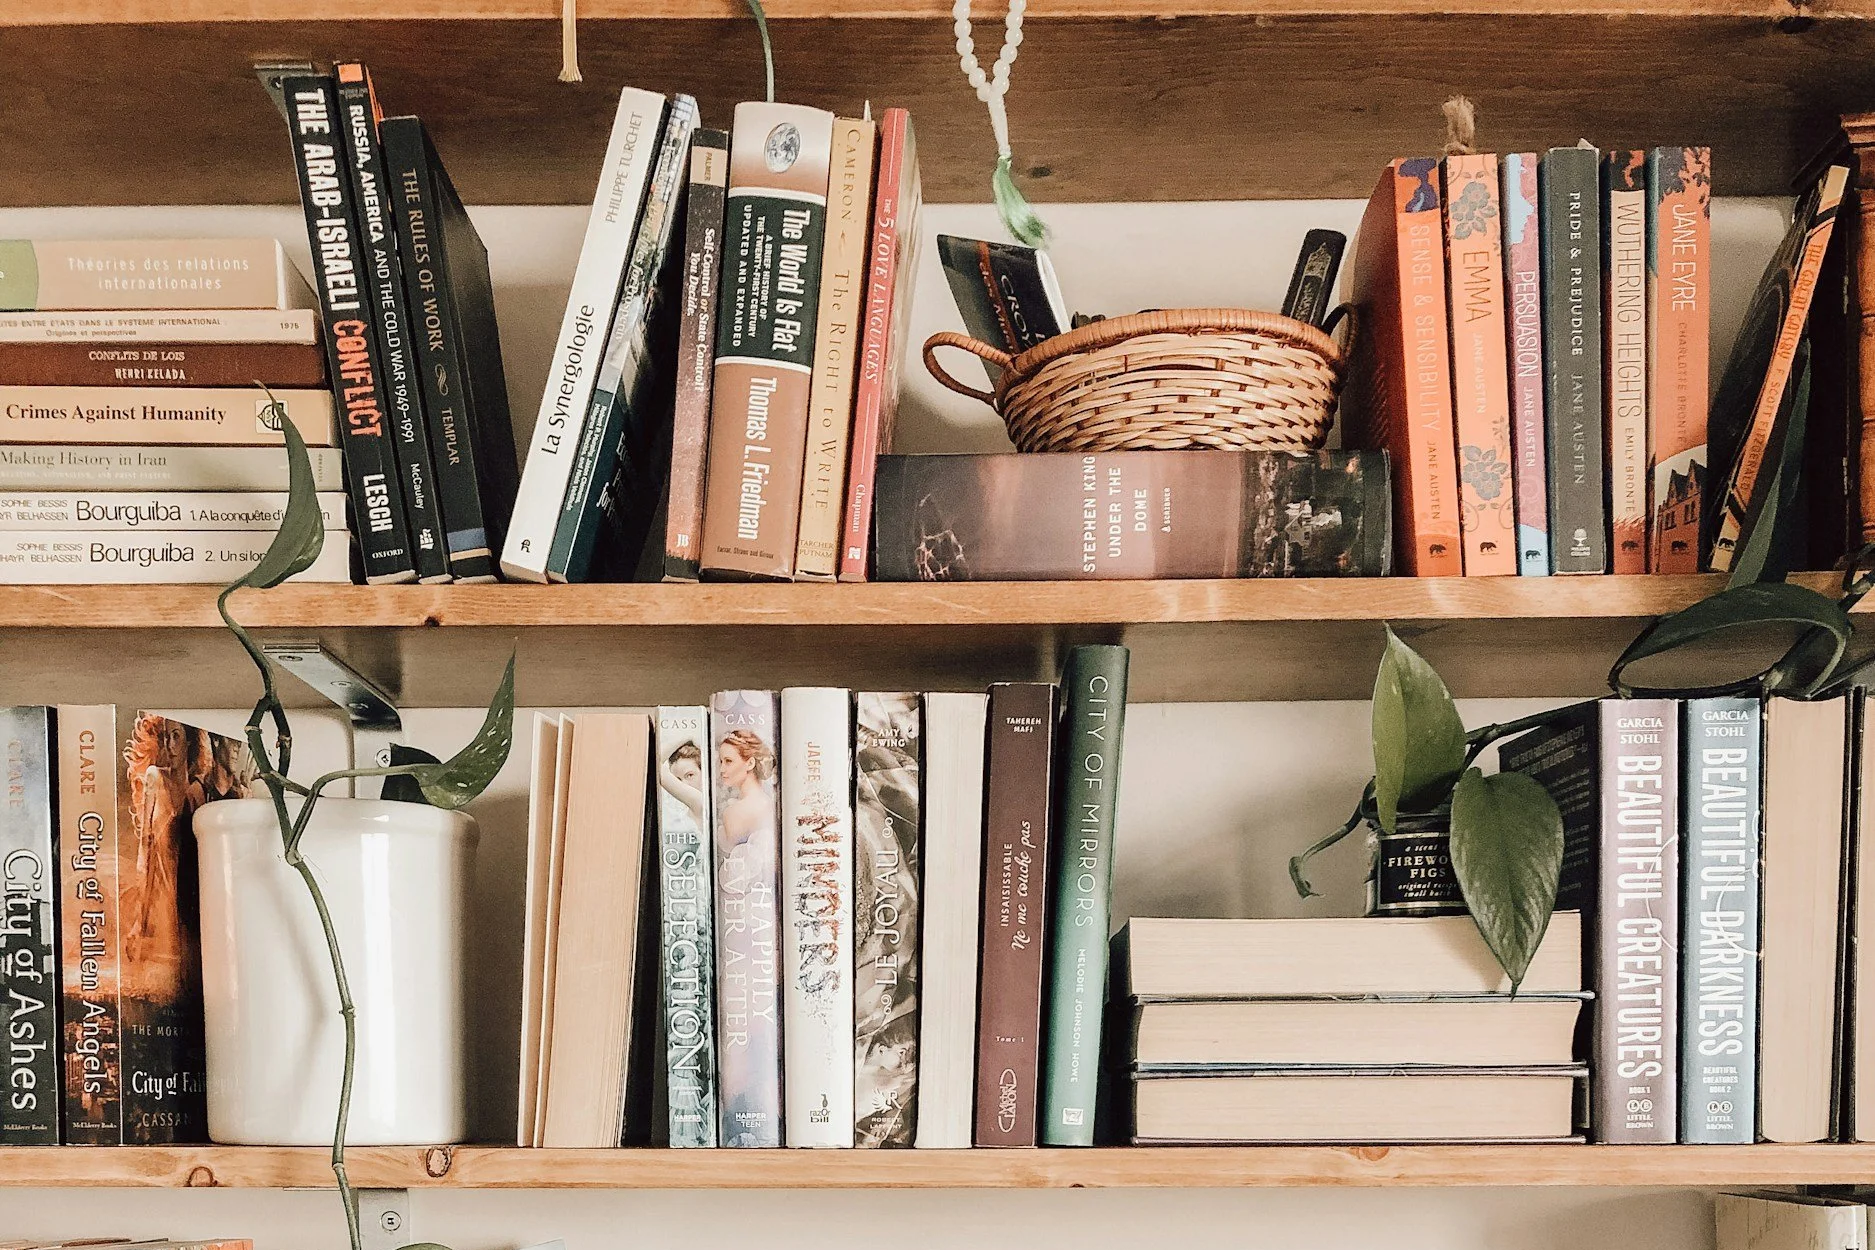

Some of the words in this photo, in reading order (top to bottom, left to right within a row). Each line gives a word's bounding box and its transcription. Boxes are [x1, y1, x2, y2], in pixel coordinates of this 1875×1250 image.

[295, 87, 330, 135] THE
[403, 168, 420, 204] THE
[841, 129, 861, 221] CAMERON
[303, 143, 360, 311] ARAB-ISRAELI
[409, 210, 430, 264] RULES
[782, 209, 811, 240] The
[1569, 192, 1581, 240] PRIDE
[1671, 204, 1697, 257] JANE
[144, 257, 170, 272] des
[178, 257, 249, 272] relations
[349, 104, 371, 168] RUSSIA,
[360, 171, 385, 243] AMERICA
[374, 249, 390, 280] AND
[395, 384, 414, 443] 1949-1991
[419, 270, 436, 294] OF
[777, 245, 808, 295] World
[874, 232, 891, 279] LOVE
[1410, 225, 1432, 286] SENSE
[1616, 202, 1642, 325] WUTHERING
[98, 276, 223, 290] internationales
[833, 270, 850, 312] The
[1463, 251, 1493, 323] EMMA
[1672, 262, 1696, 312] EYRE
[423, 298, 444, 351] WORK
[772, 318, 801, 352] Flat
[1515, 270, 1539, 378] PERSUASION
[1570, 268, 1583, 356] PREJUDICE
[89, 351, 139, 361] CONFLITS
[333, 320, 382, 437] CONFLICT
[549, 304, 594, 429] Synergologie
[826, 322, 847, 392] RIGHT
[1415, 314, 1440, 432] SENSIBILITY
[1617, 332, 1642, 420] HEIGHTS
[6, 403, 67, 420] Crimes
[71, 404, 136, 424] Against
[141, 405, 227, 424] Humanity
[746, 377, 778, 441] Thomas
[1571, 373, 1583, 415] JANE
[59, 451, 112, 466] History
[137, 452, 167, 466] Iran
[541, 434, 560, 455] La
[1525, 421, 1536, 467] AUSTEN
[1573, 421, 1585, 485] AUSTEN
[815, 439, 837, 510] WRITE
[1083, 456, 1096, 491] KING
[1109, 467, 1121, 496] THE
[1428, 475, 1441, 520] AUSTEN
[77, 500, 181, 526] Bourguiba
[363, 473, 393, 532] LESCH
[737, 462, 770, 540] Friedman
[853, 484, 865, 533] Chapman
[1135, 489, 1147, 532] DOME
[90, 542, 194, 568] Bourguiba
[1083, 498, 1096, 573] STEPHEN
[1109, 502, 1121, 558] UNDER
[661, 719, 697, 729] CASS
[725, 714, 765, 725] CASS
[1087, 676, 1109, 742] CITY
[1617, 718, 1663, 728] GARCIA
[1702, 711, 1749, 721] GARCIA
[1705, 727, 1746, 737] STOHL
[79, 730, 96, 794] CLARE
[1620, 733, 1661, 743] STOHL
[1083, 753, 1104, 791] OF
[72, 811, 104, 872] City
[1617, 756, 1662, 907] BEAUTIFUL
[1701, 749, 1747, 900] BEAUTIFUL
[1000, 843, 1013, 927] INSAISISSABLE
[1074, 804, 1101, 928] MIRRORS
[1410, 868, 1446, 878] FIGS
[0, 849, 43, 937] City
[723, 857, 746, 937] EVER
[874, 847, 899, 945] JOYAU
[80, 910, 106, 991] Fallen
[663, 849, 704, 1073] SELECTION
[751, 882, 775, 1025] HAPPILY
[875, 954, 899, 986] LE
[1076, 949, 1086, 993] MELODIE
[724, 946, 748, 1049] AFTER
[1617, 918, 1662, 1078] CREATURES
[1699, 911, 1745, 1056] DARKNESS
[9, 988, 46, 1110] Ashes
[75, 1000, 108, 1094] Angels
[1073, 998, 1083, 1047] JOHNSON
[132, 1071, 163, 1100] City
[1070, 1054, 1080, 1083] HOWE
